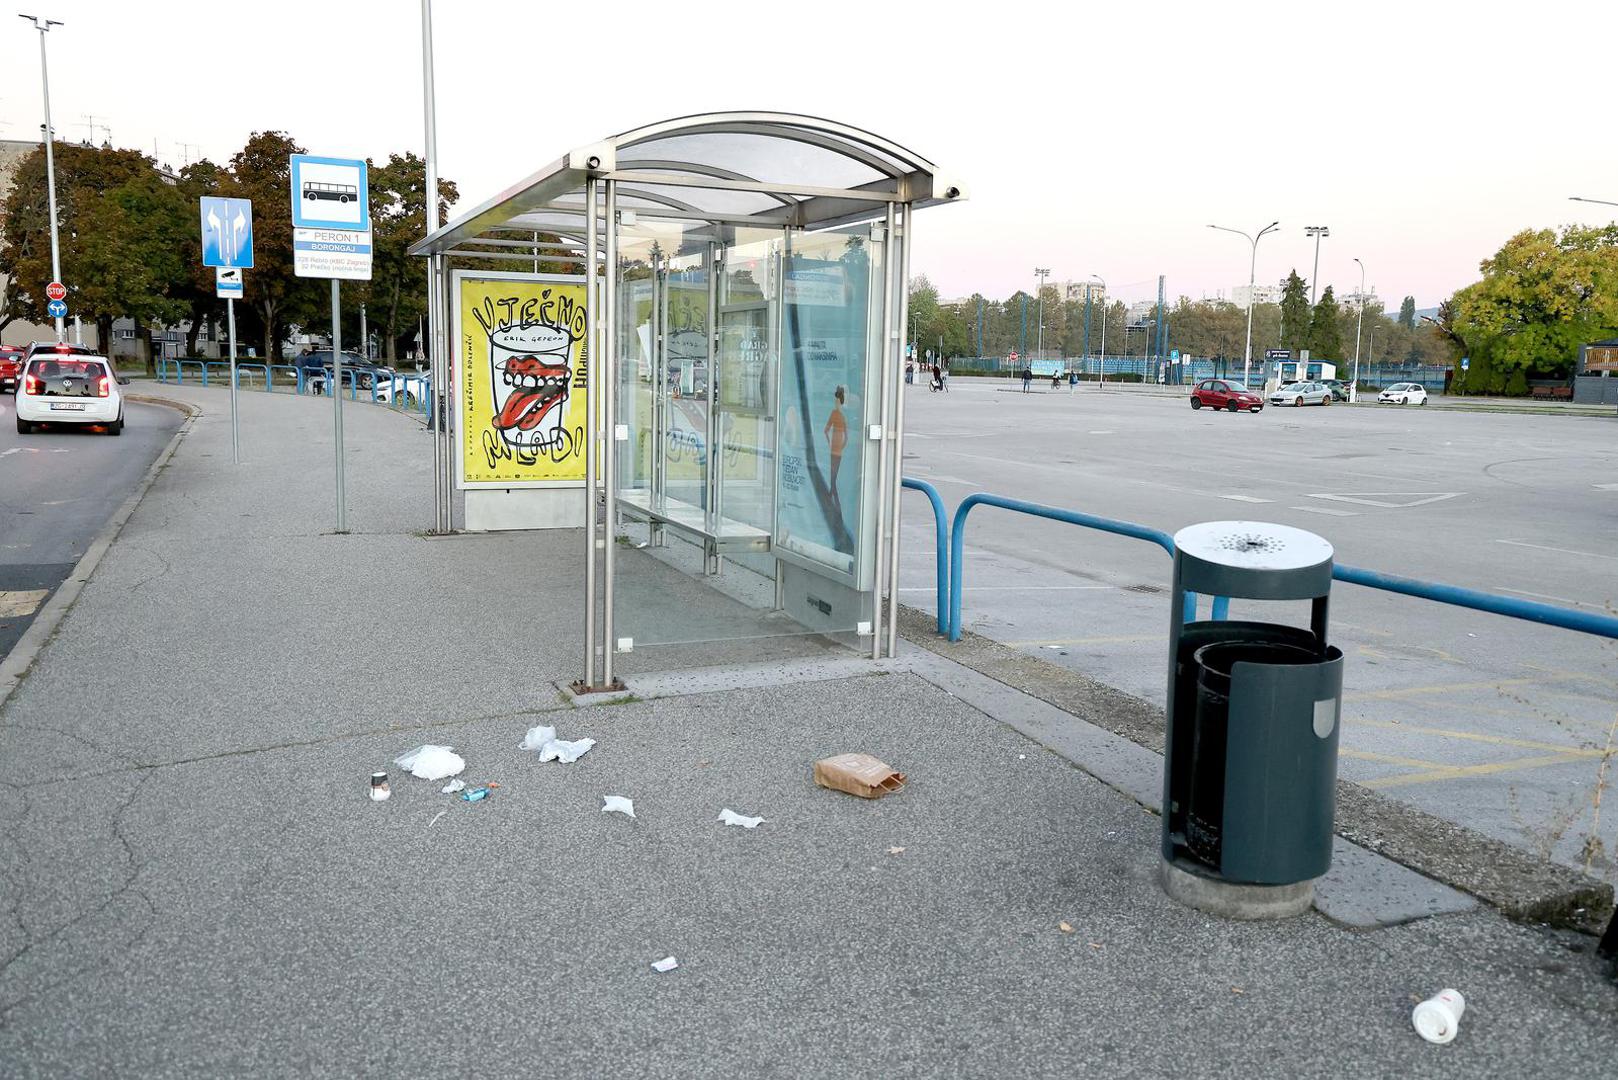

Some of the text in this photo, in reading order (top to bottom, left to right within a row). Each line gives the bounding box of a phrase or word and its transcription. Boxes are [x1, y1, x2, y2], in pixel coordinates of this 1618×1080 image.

[314, 231, 359, 243] PERON 1
[311, 243, 356, 252] BORONGAJ
[48, 287, 65, 295] STOP
[472, 289, 587, 341] VJEČNO
[503, 335, 526, 343] ERIK
[483, 426, 584, 469] MLADI
